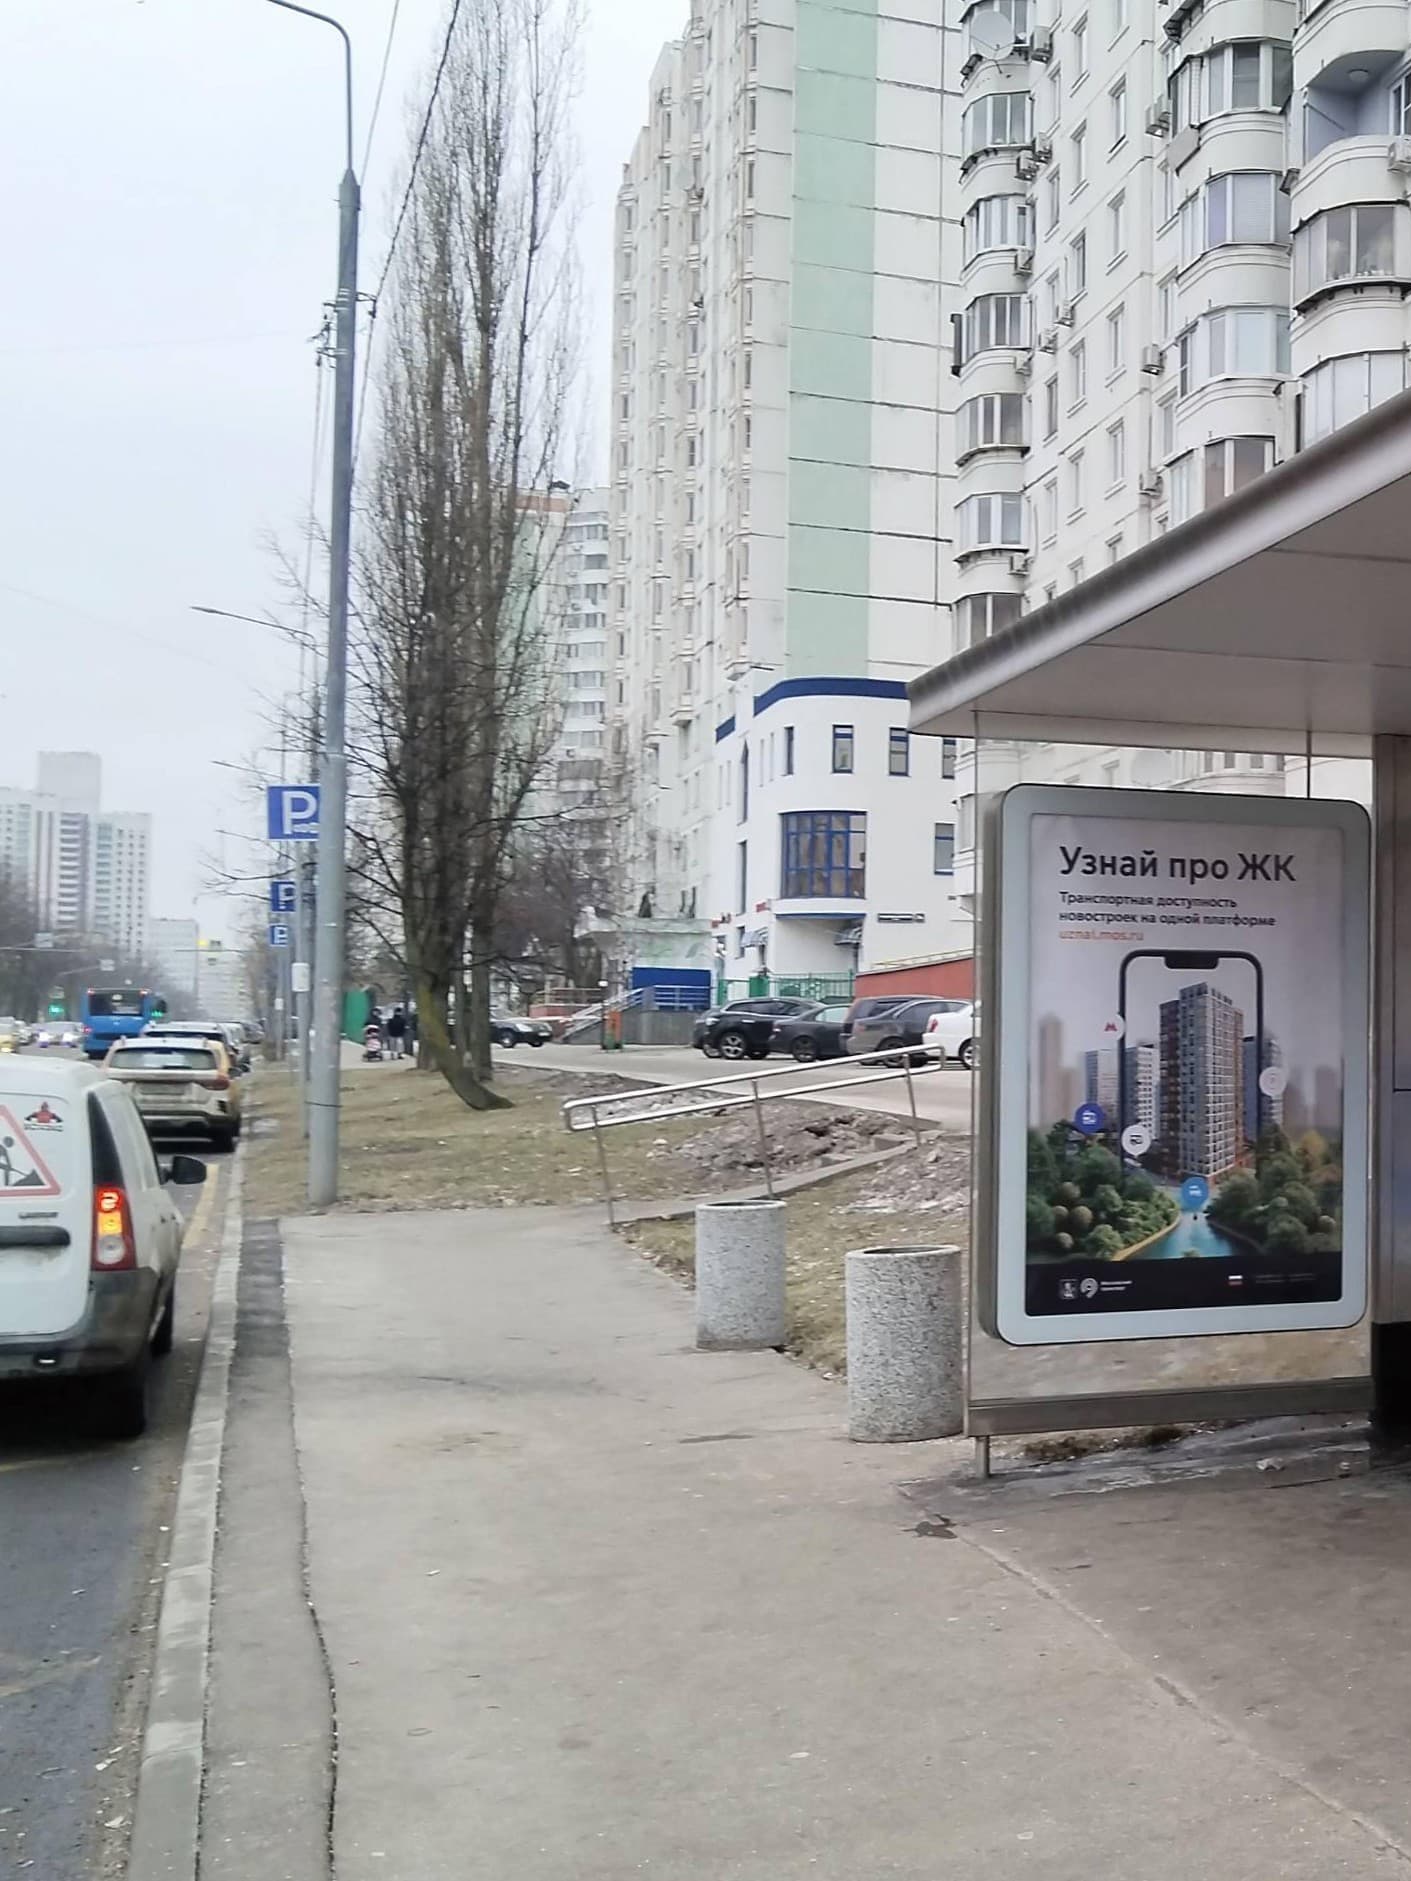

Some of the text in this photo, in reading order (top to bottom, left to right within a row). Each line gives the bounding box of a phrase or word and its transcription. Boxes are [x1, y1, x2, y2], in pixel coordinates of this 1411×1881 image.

[282, 790, 318, 835] P
[1059, 846, 1297, 885] Узнай про ЖК
[1058, 891, 1238, 909] Транспортная доступность
[1058, 911, 1277, 928] новостроек на одной платформе
